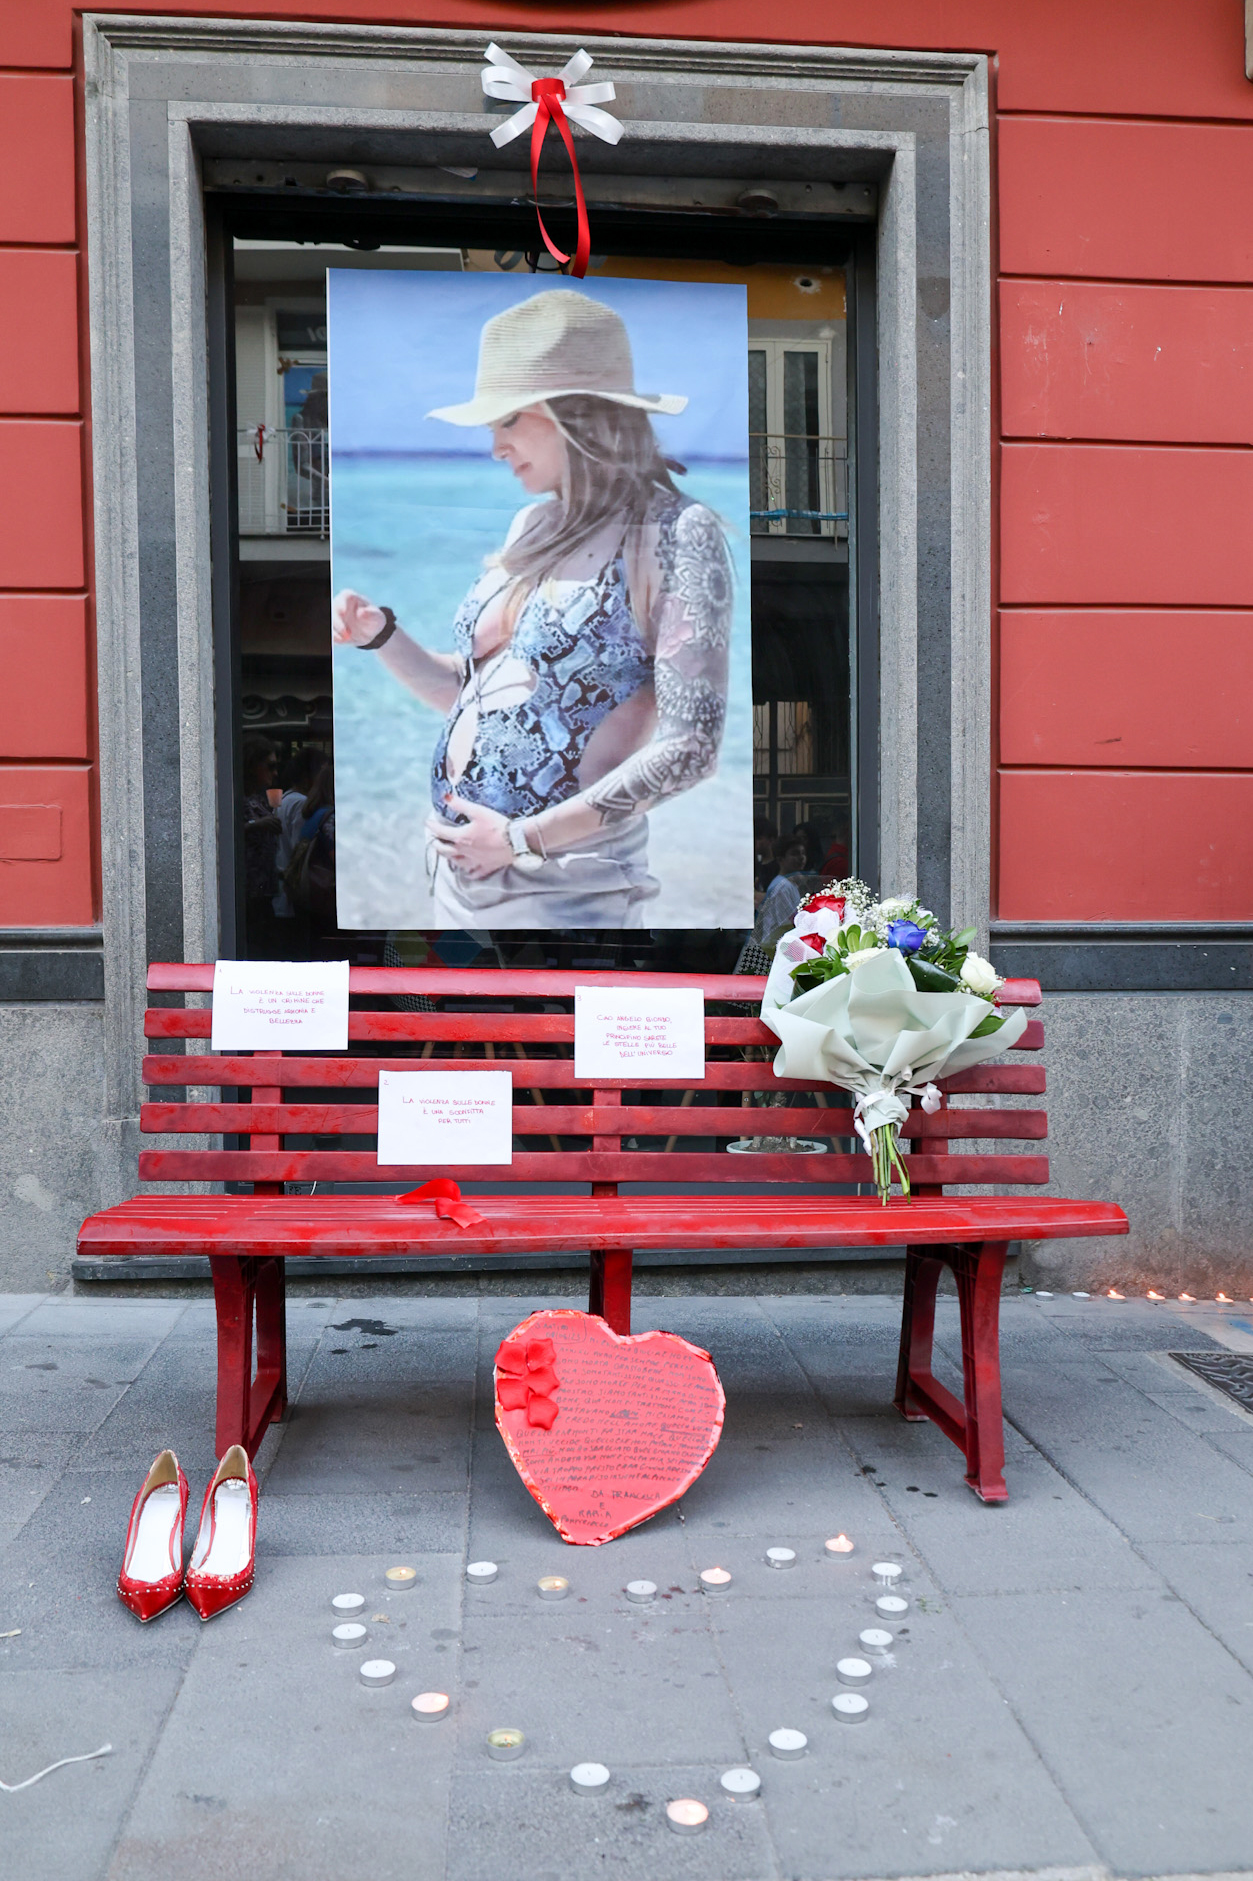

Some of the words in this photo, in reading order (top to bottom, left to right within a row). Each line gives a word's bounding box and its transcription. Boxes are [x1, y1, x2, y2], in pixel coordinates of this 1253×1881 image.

[230, 985, 244, 995] LA
[402, 1096, 415, 1104] LA
[449, 1108, 484, 1116] SCONFITTA
